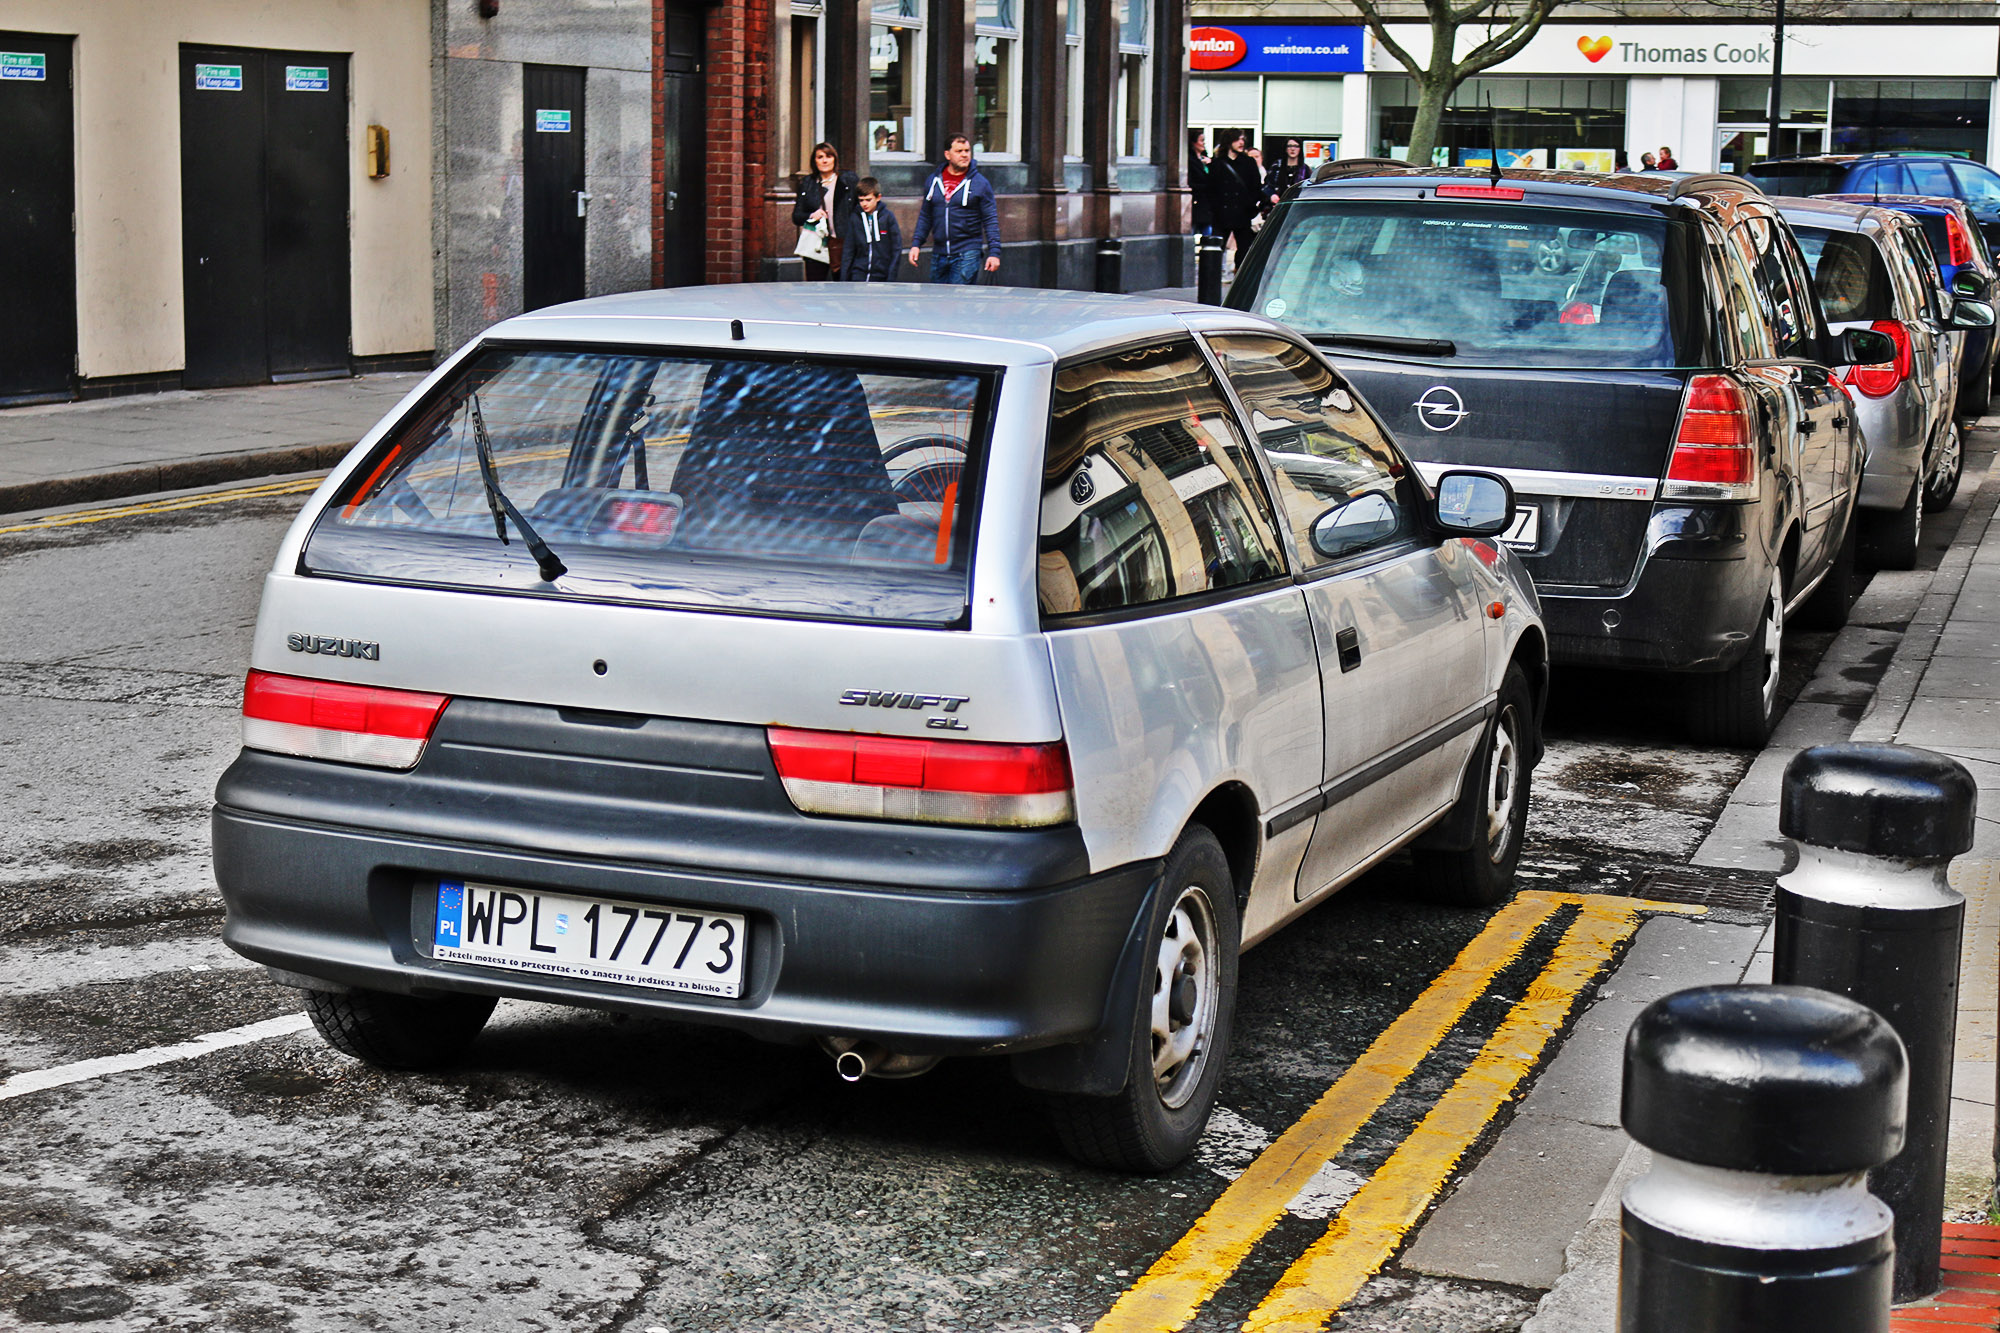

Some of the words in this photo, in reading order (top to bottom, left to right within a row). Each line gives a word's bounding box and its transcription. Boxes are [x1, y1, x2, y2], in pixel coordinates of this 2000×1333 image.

[1190, 37, 1235, 51] winton
[1263, 44, 1350, 54] swinton.co.uk
[1619, 43, 1707, 63] Thomas
[1713, 43, 1770, 63] Cook
[3, 55, 17, 65] Fire
[18, 57, 32, 65] exit
[3, 67, 21, 77] Keep
[22, 68, 39, 77] clear
[206, 67, 218, 76] Fire
[296, 69, 307, 77] Fire
[308, 70, 319, 78] exit
[206, 78, 221, 88] Keep
[221, 79, 237, 87] clear
[296, 79, 310, 89] Keep
[310, 80, 324, 88] clear
[1616, 486, 1647, 496] CDTI
[287, 632, 380, 661] SUZUKI
[839, 688, 970, 713] SWIFT
[925, 716, 969, 731] GL
[440, 919, 458, 937] PL
[467, 888, 557, 954] WPL
[583, 903, 736, 974] 17773
[592, 970, 623, 981] znaczy
[638, 976, 676, 987] jedziesz
[678, 981, 689, 989] za
[691, 982, 721, 993] blisko
